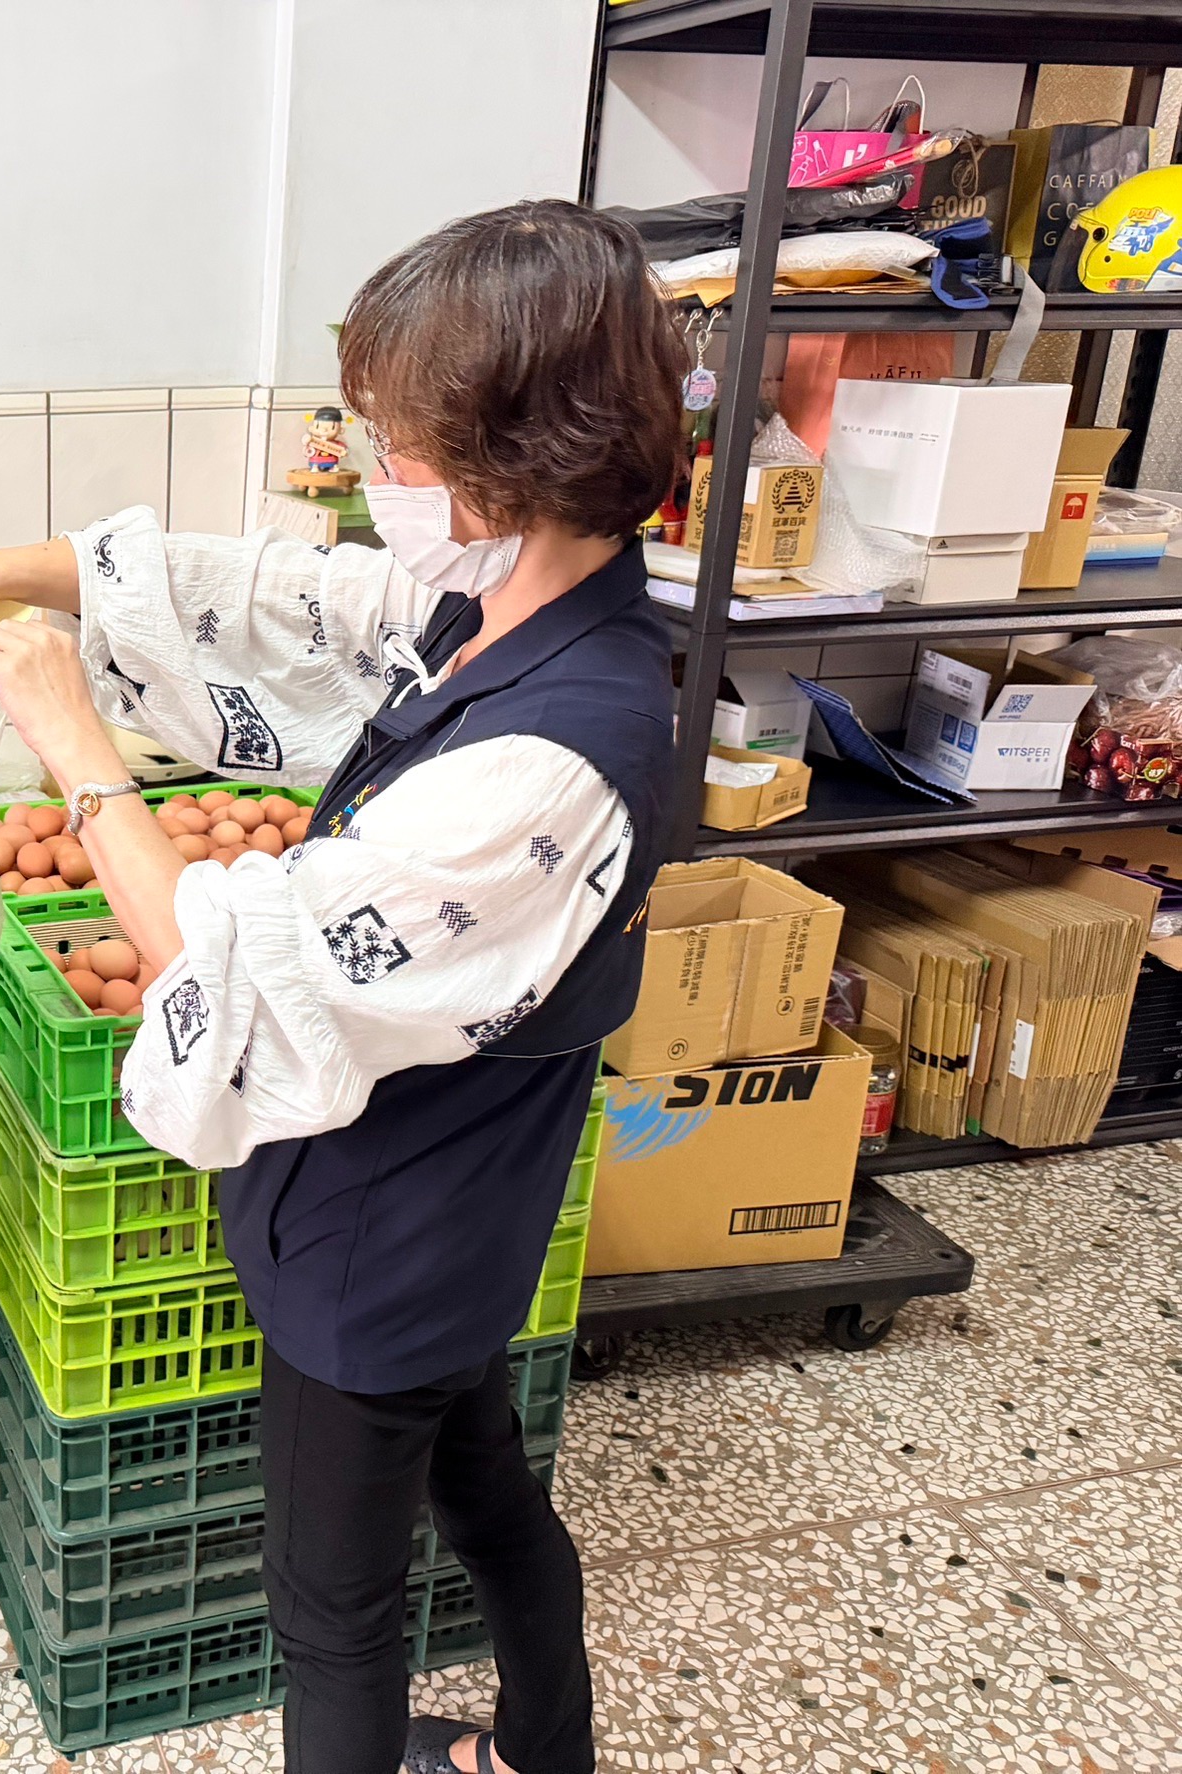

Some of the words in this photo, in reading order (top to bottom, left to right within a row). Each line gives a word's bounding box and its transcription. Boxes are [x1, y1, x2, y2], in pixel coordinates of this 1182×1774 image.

[931, 195, 987, 218] GOOD
[998, 747, 1050, 757] WITSPER
[665, 1063, 823, 1109] SION
